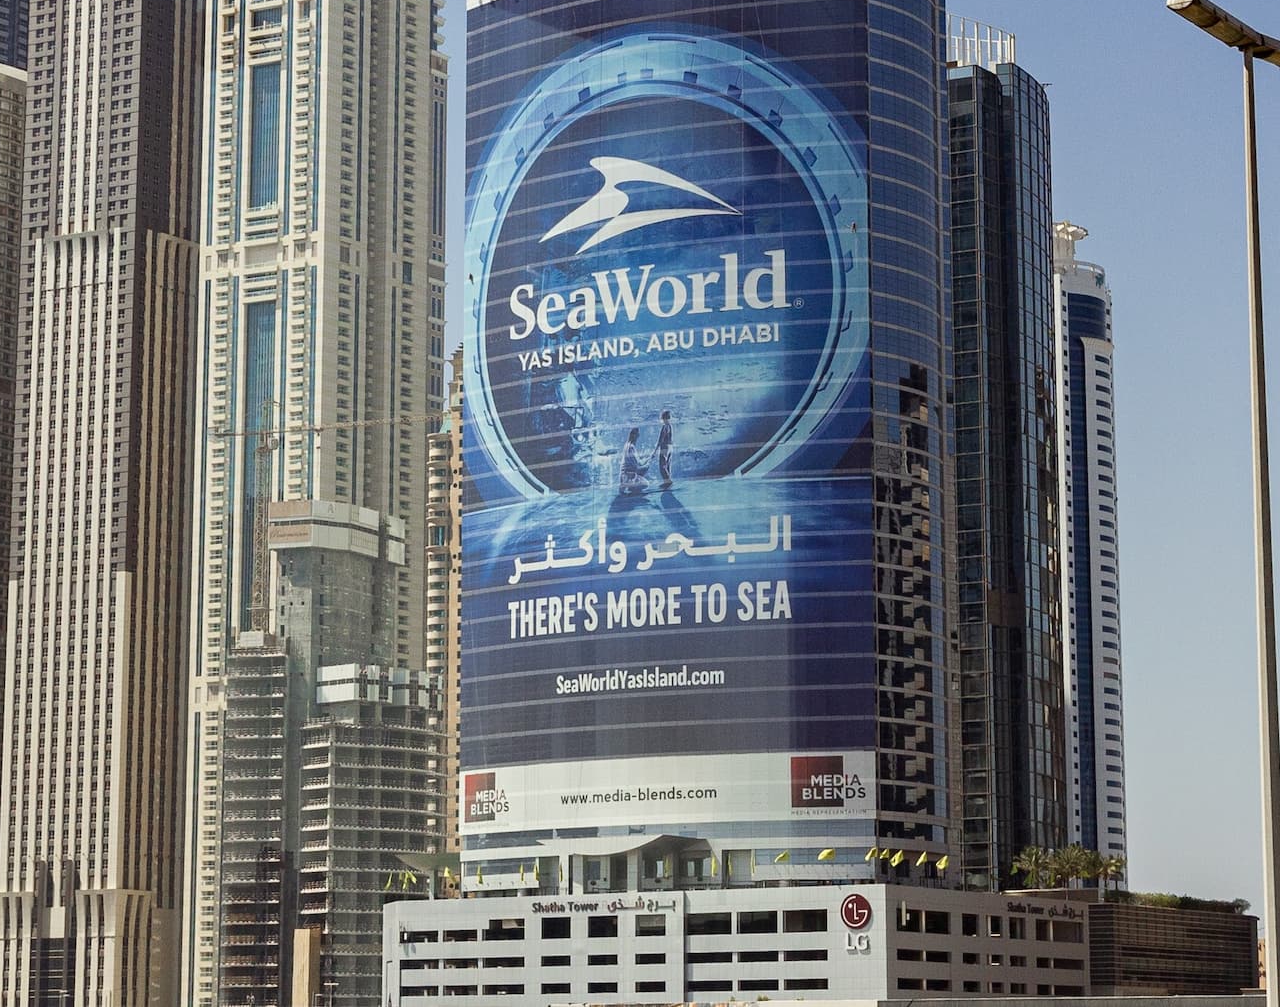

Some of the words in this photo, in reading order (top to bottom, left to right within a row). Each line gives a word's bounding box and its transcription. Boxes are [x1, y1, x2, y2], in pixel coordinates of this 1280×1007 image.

[519, 352, 553, 371] YAS
[558, 337, 640, 366] ISLAND,
[646, 330, 695, 353] ABU
[702, 322, 780, 345] DHABI
[507, 516, 628, 585] وأكثر
[636, 514, 792, 571] البحر
[507, 591, 599, 639] THERE'S
[606, 586, 682, 629] MORE
[691, 583, 728, 624] TO
[736, 580, 792, 622] SEA
[556, 665, 725, 694] SeaWorldYasIsland.com
[810, 773, 862, 787] MEDIA
[475, 789, 507, 802] MEDIA
[560, 786, 717, 804] www.media-blends.com
[802, 787, 866, 800] BLENDS
[470, 801, 510, 815] BLENDS
[532, 902, 565, 913] Shatha
[568, 901, 599, 912] Tower
[846, 932, 871, 950] LG
